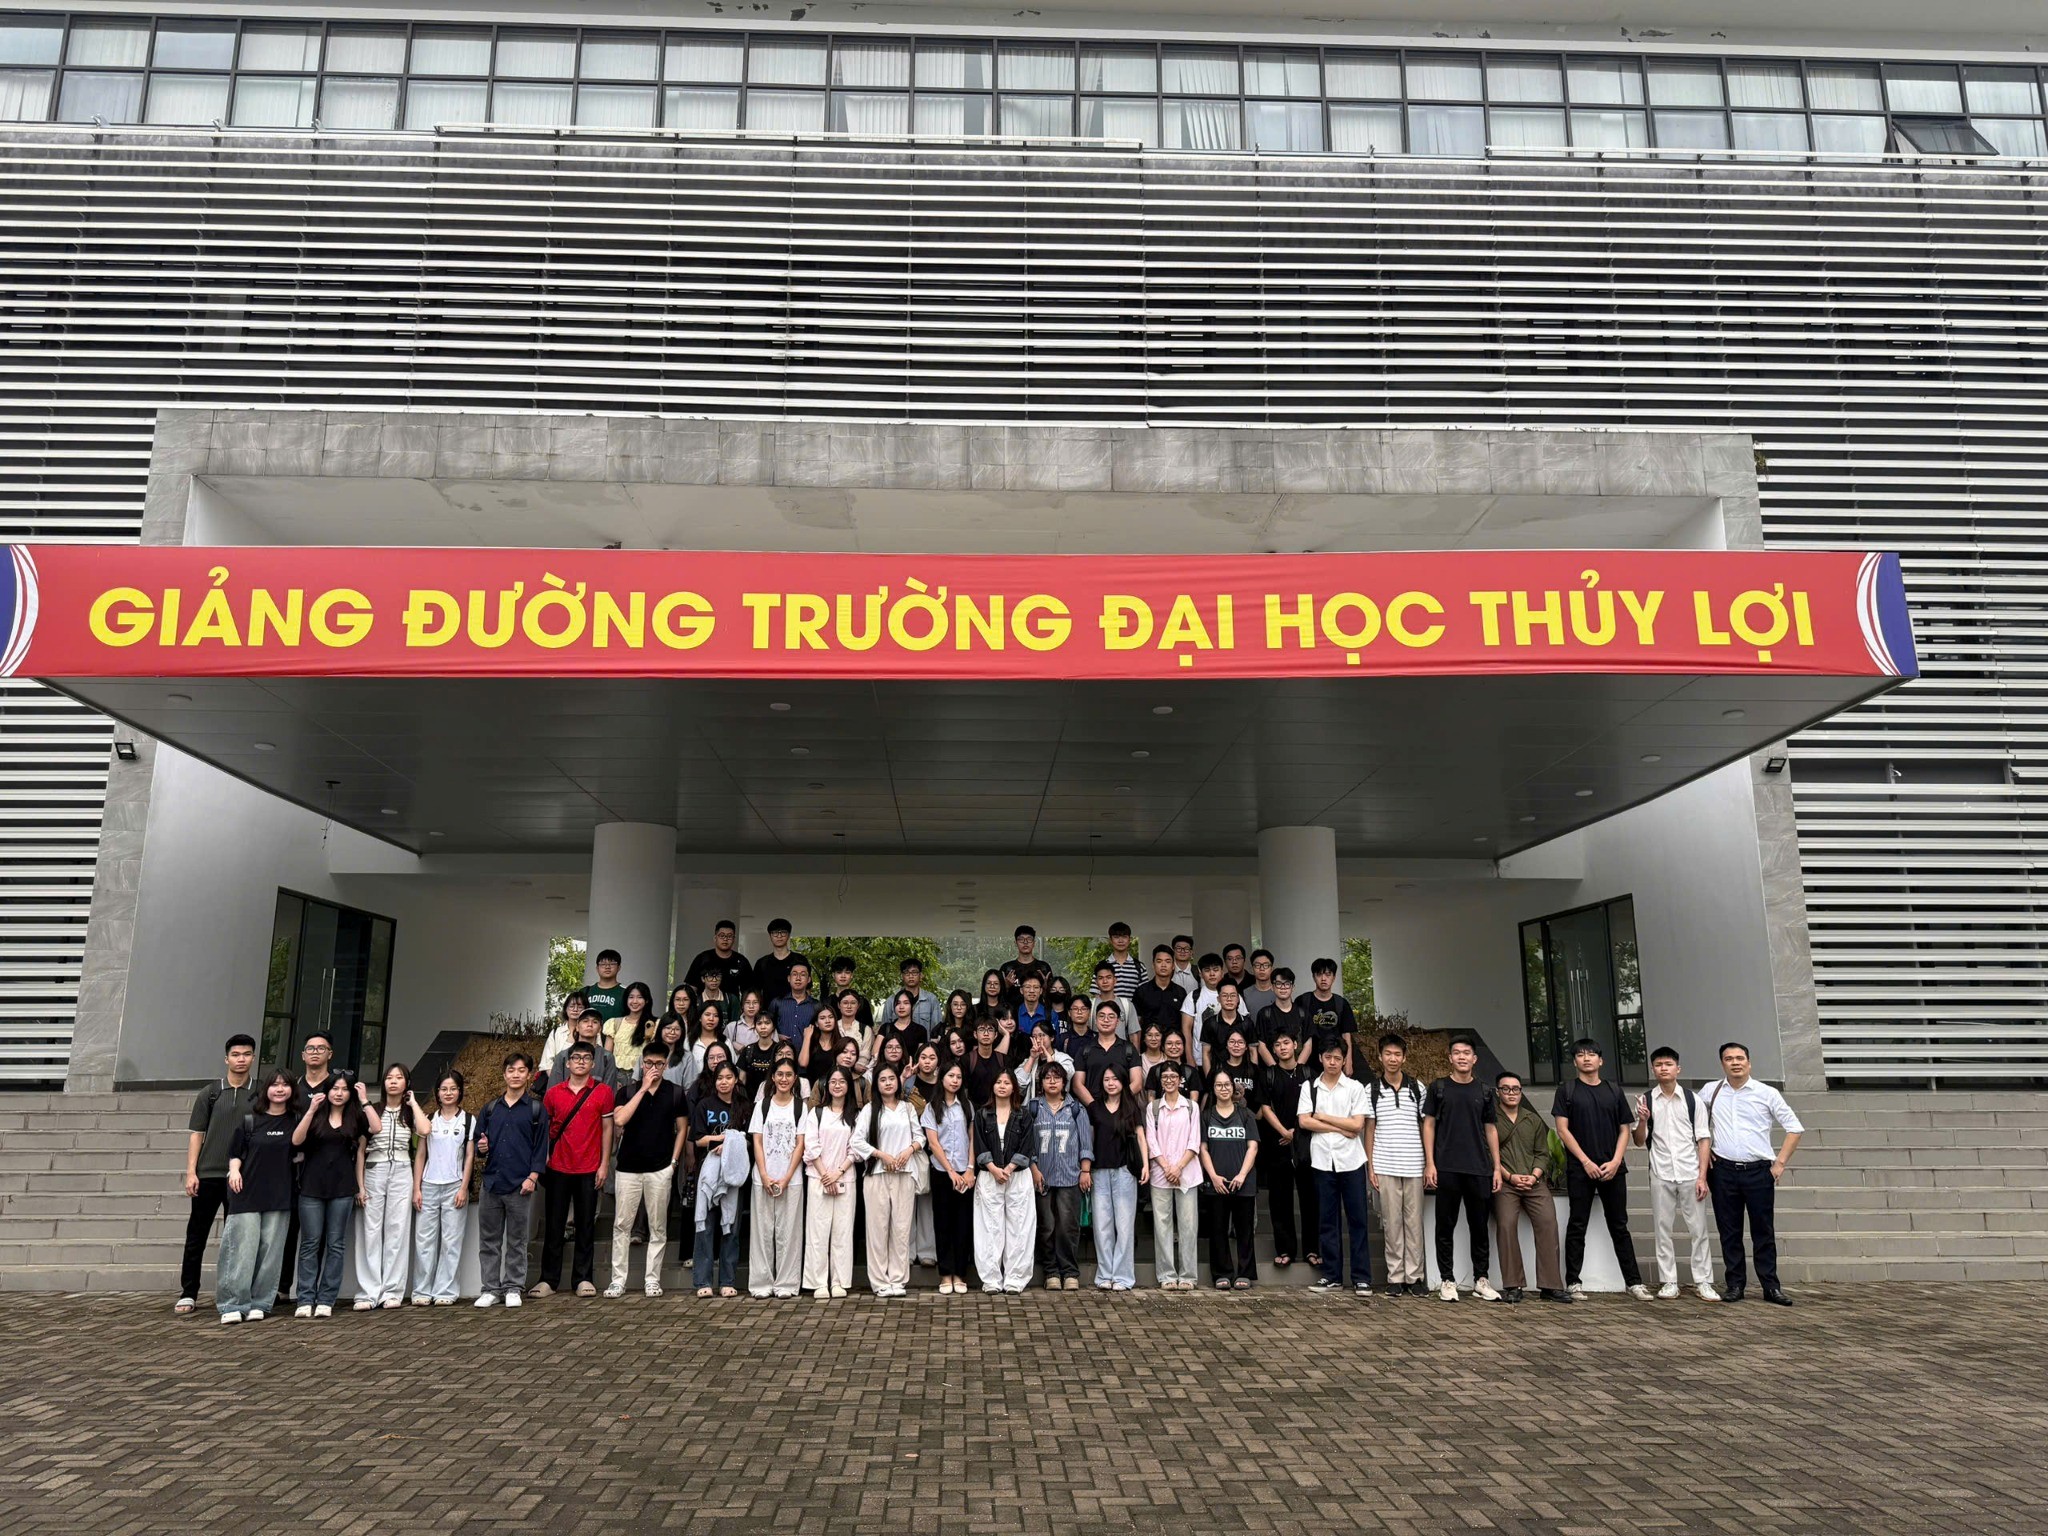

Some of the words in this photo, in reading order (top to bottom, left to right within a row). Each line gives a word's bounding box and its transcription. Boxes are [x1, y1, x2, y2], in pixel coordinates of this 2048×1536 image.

[88, 566, 374, 649] GIẢNG
[403, 573, 716, 652] ĐƯỜNG
[743, 577, 1073, 652] TRƯỜNG
[1100, 594, 1235, 667] ĐẠI
[1265, 592, 1446, 665] HỌC
[1470, 570, 1665, 649] THỦY
[1694, 584, 1815, 664] LỢI
[588, 994, 616, 1007] ADIDAS
[1209, 1128, 1245, 1138] PARIS
